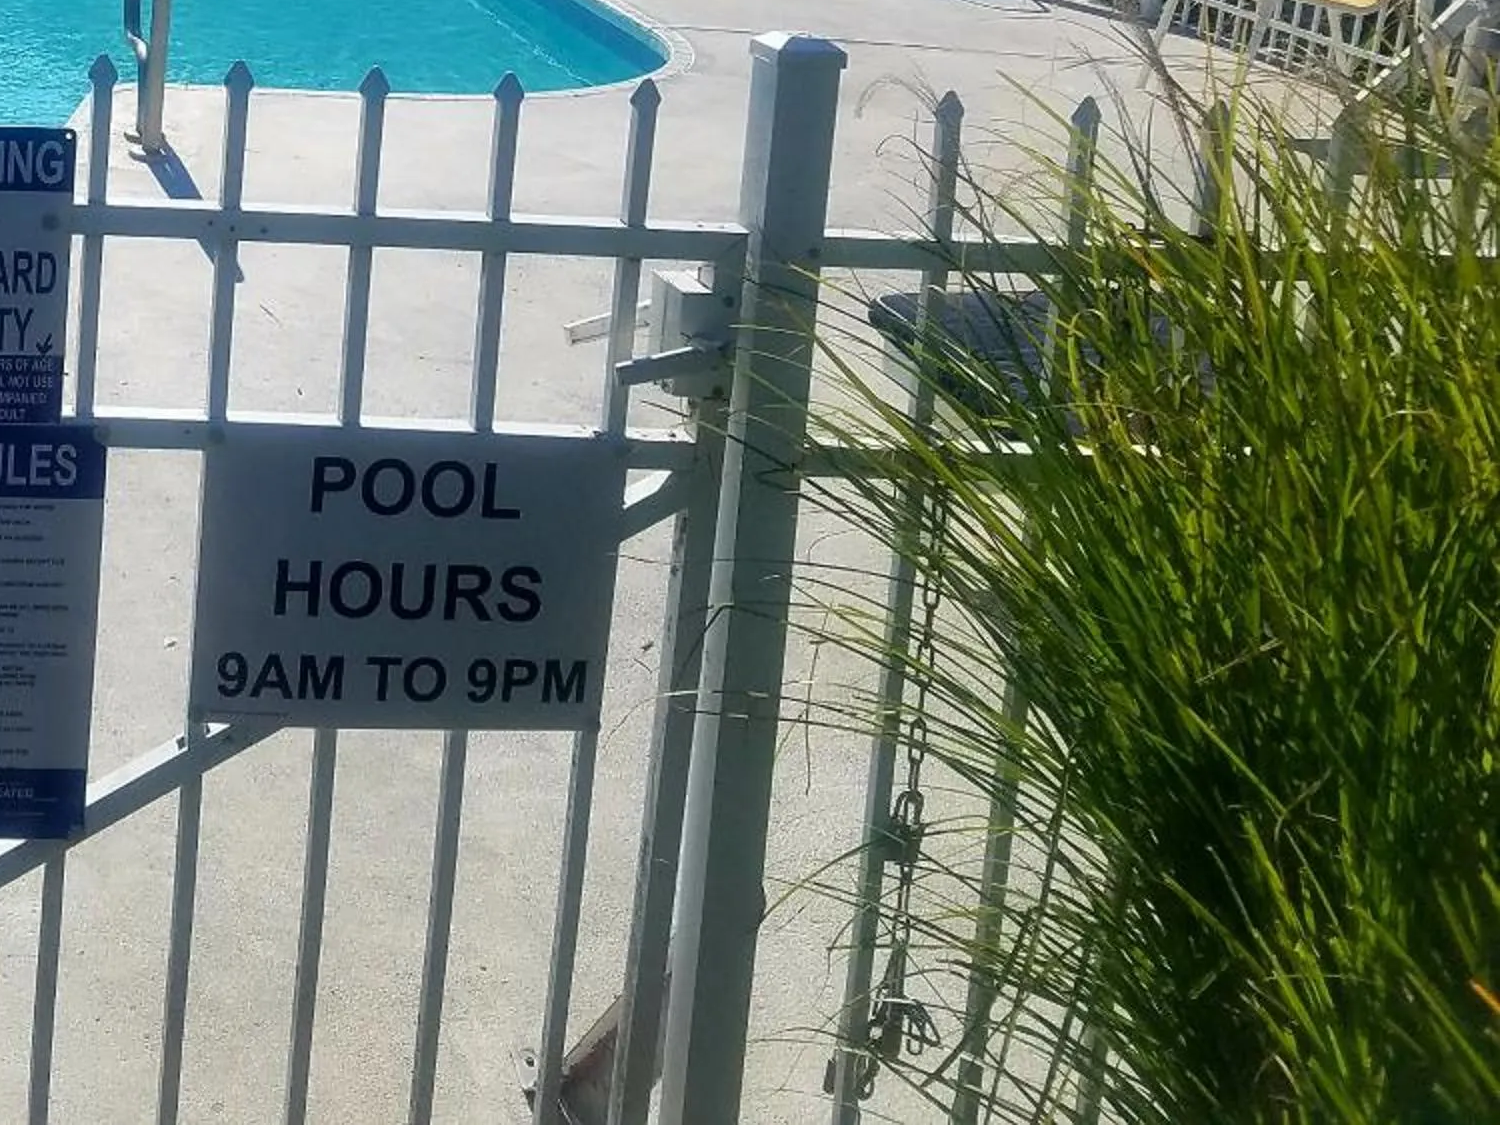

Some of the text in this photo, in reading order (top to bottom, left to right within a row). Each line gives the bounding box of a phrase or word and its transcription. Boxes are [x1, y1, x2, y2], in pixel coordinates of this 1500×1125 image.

[310, 456, 521, 520] POOL
[273, 559, 542, 622] HOURS
[217, 651, 587, 704] 9AM TO 9PM
